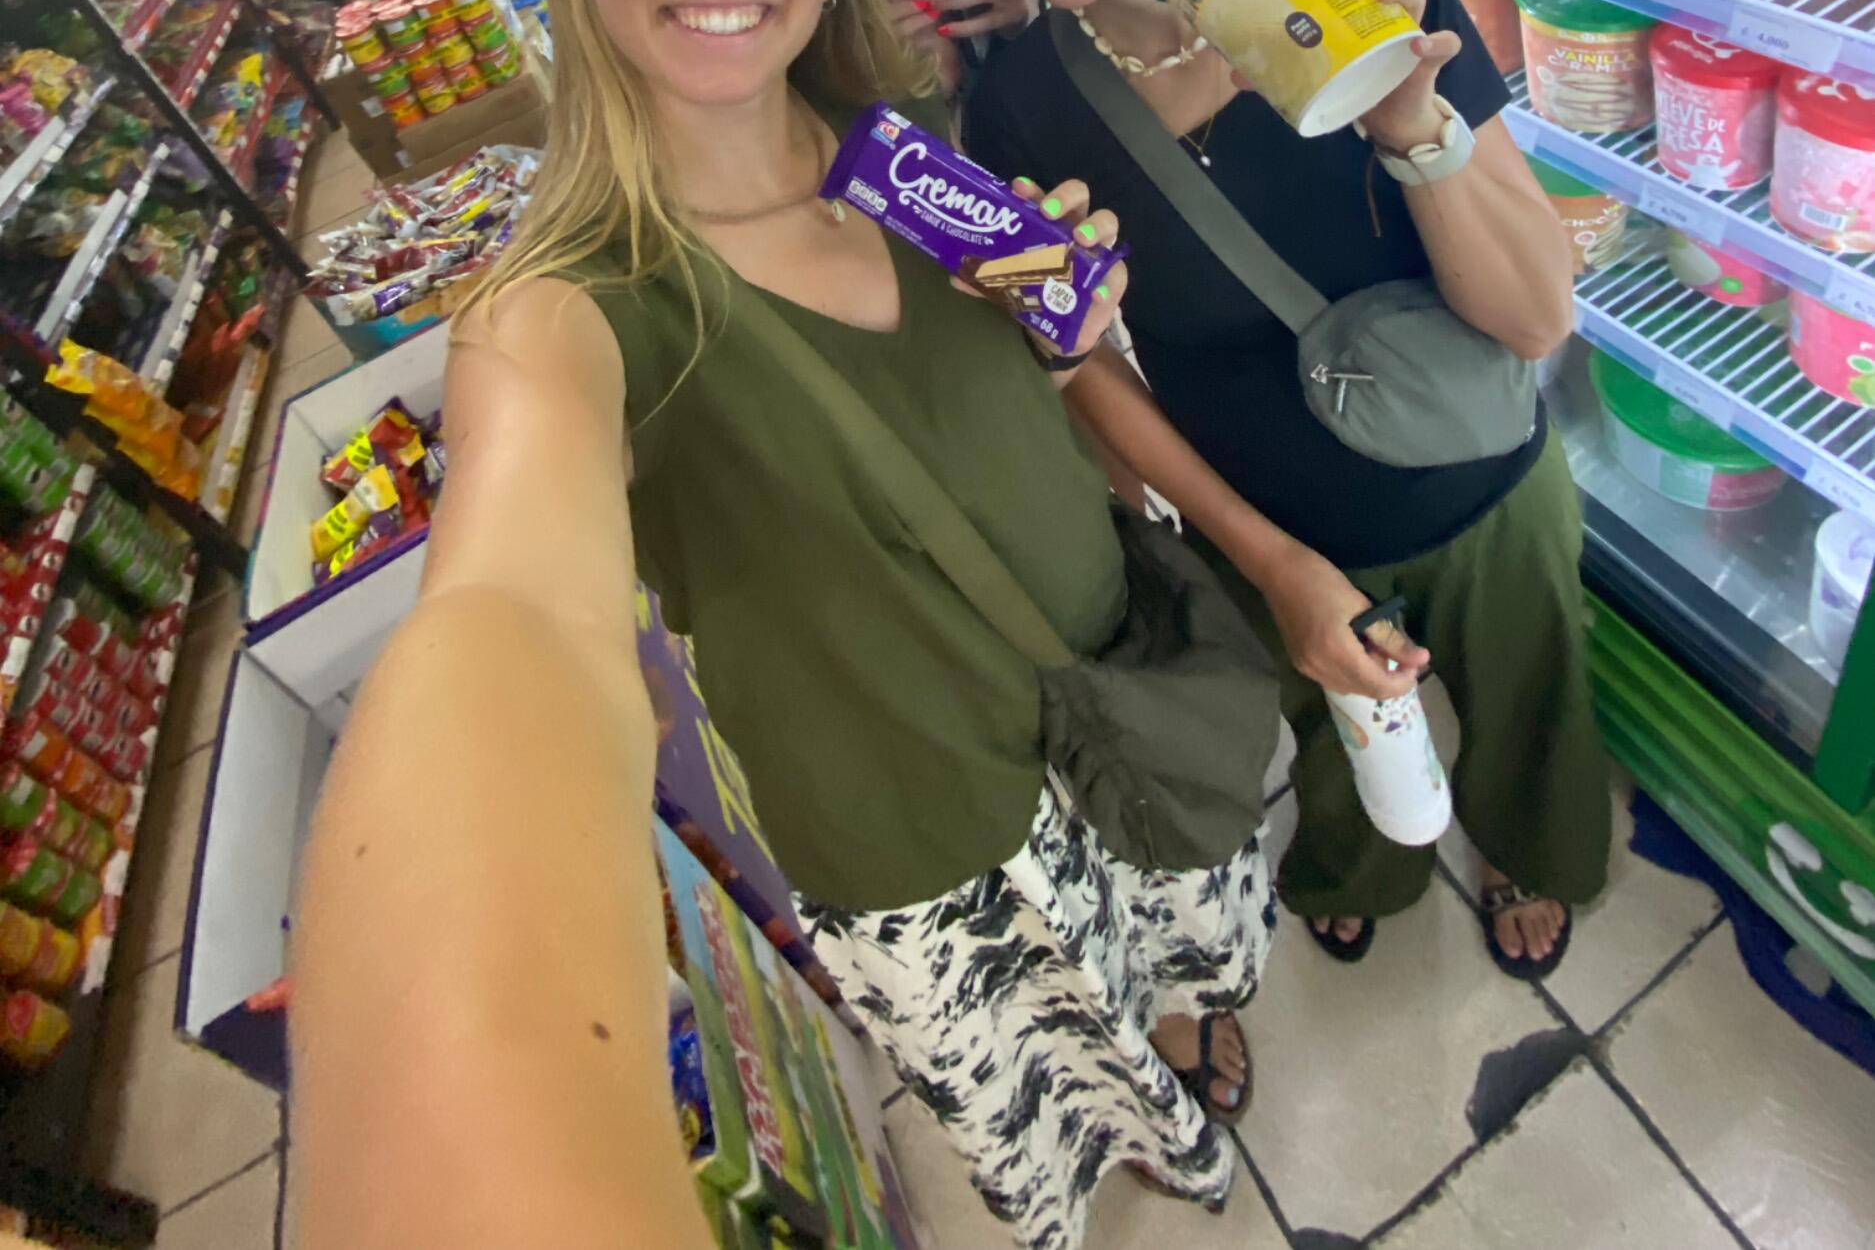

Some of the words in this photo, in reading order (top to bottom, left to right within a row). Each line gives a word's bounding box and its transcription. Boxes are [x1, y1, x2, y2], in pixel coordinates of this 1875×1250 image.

[1553, 47, 1637, 64] VAINILLA
[1708, 117, 1727, 133] DE
[889, 142, 1023, 235] Cremax
